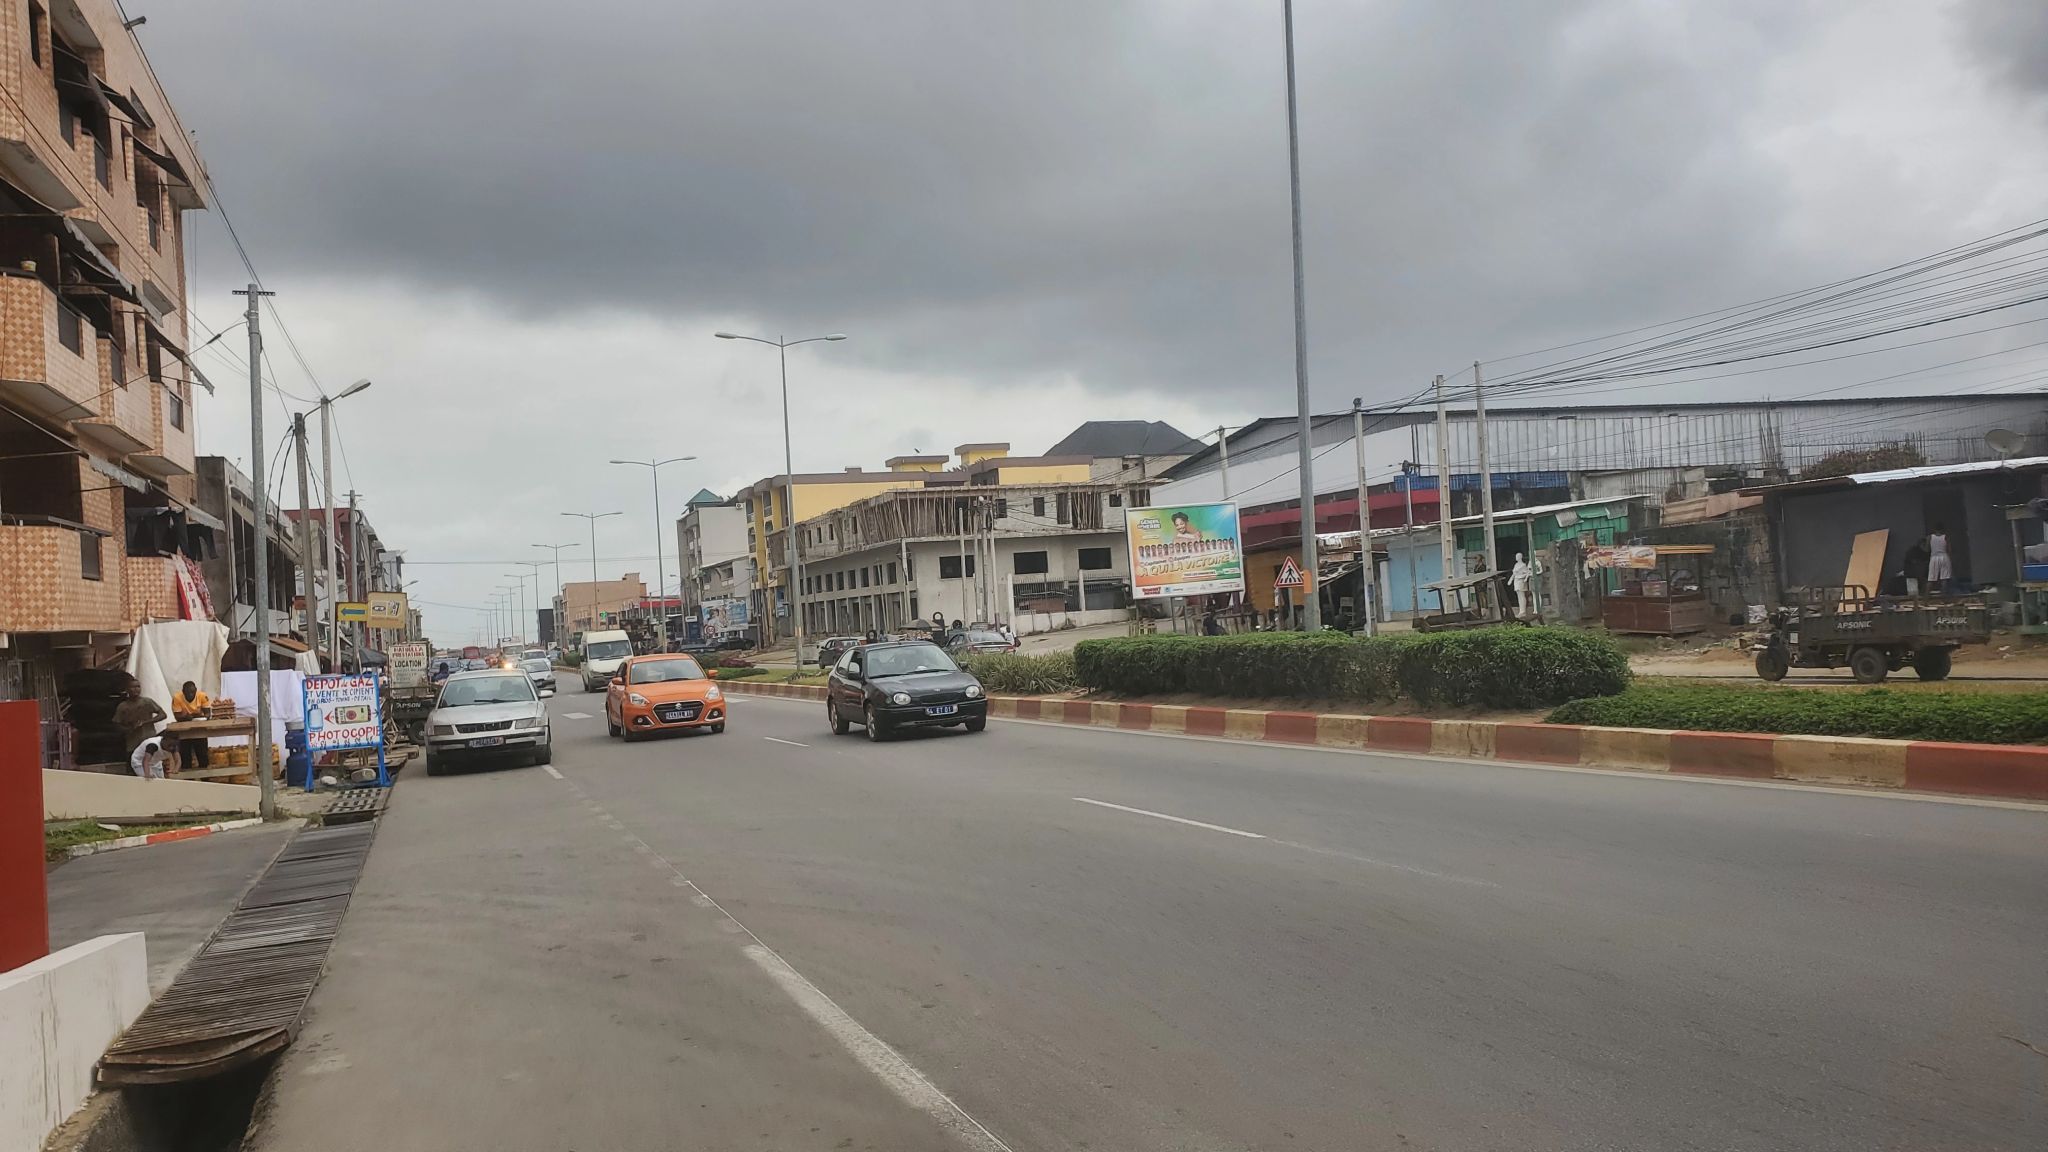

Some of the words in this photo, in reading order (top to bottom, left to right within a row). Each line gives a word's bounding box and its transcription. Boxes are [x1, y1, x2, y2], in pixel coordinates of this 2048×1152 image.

[1151, 565, 1169, 574] QUI
[1171, 562, 1184, 572] LA
[1185, 555, 1231, 569] VICTOIRE
[1837, 620, 1872, 629] APSONIC
[1936, 616, 1968, 624] APSONIC
[394, 660, 421, 668] LOCATION
[306, 678, 341, 690] DEPOT
[350, 675, 374, 688] GAZ
[316, 690, 340, 698] VENTE
[309, 726, 381, 742] PHOTOCOPIE
